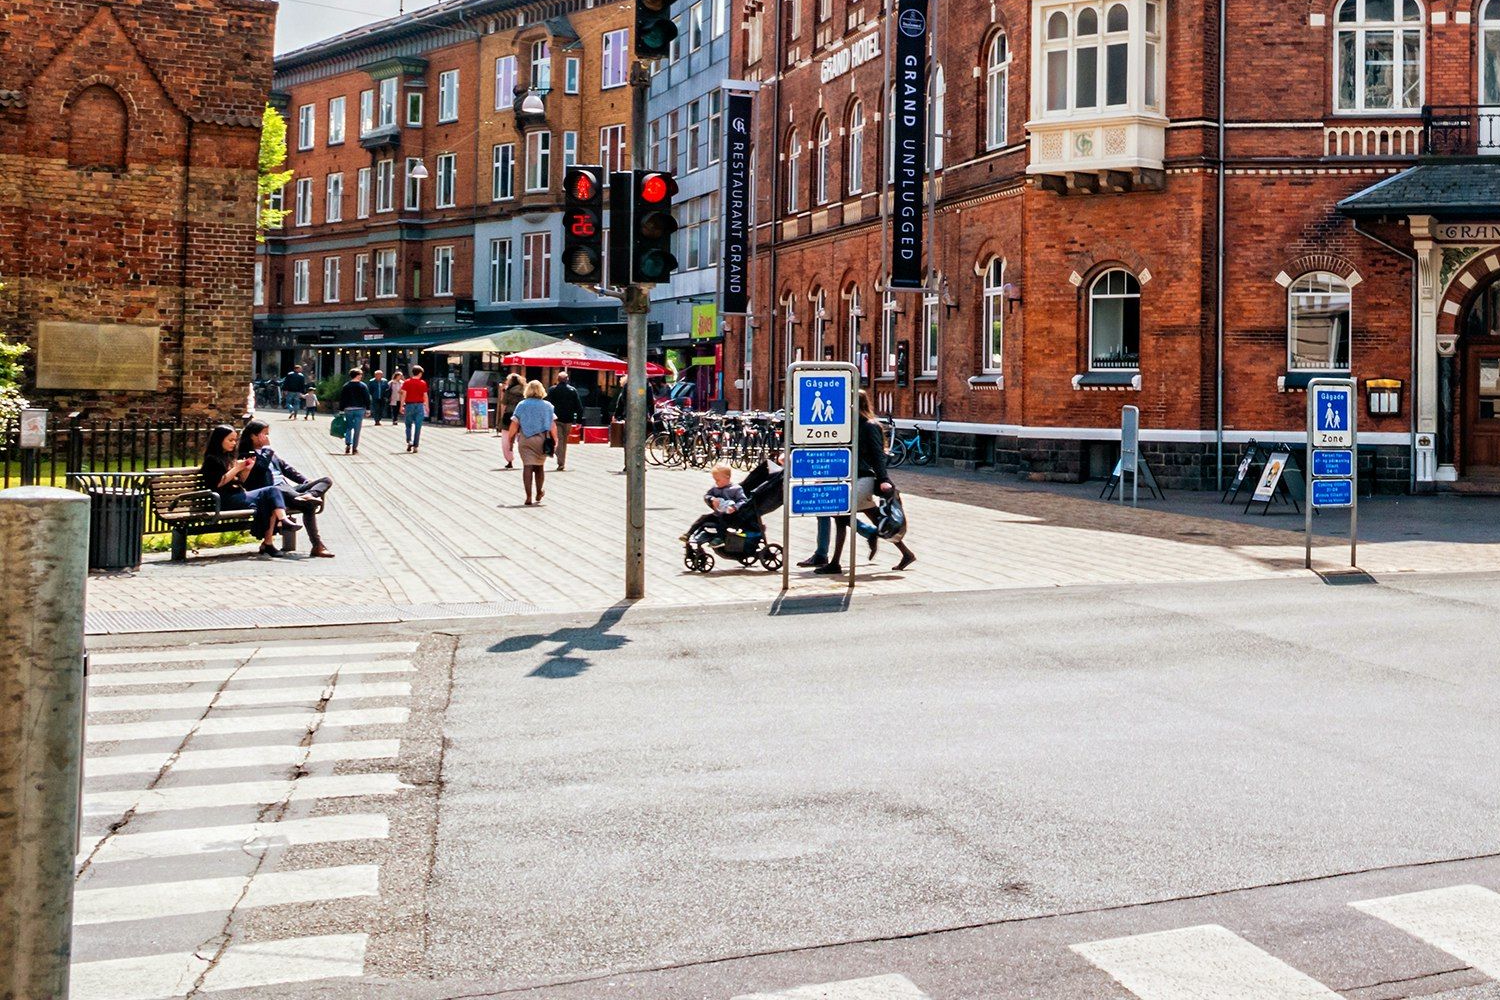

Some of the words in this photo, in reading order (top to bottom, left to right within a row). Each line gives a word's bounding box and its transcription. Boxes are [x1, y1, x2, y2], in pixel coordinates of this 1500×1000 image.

[820, 48, 851, 85] GRAND
[851, 31, 882, 69] HOTEL
[904, 55, 918, 127] GRAND
[731, 141, 745, 239] RESTAURANT
[901, 139, 916, 260] UNPLUGGED
[730, 243, 742, 294] GRAND
[805, 379, 840, 389] Gågade
[806, 428, 838, 439] Zone
[1322, 433, 1344, 443] Zone
